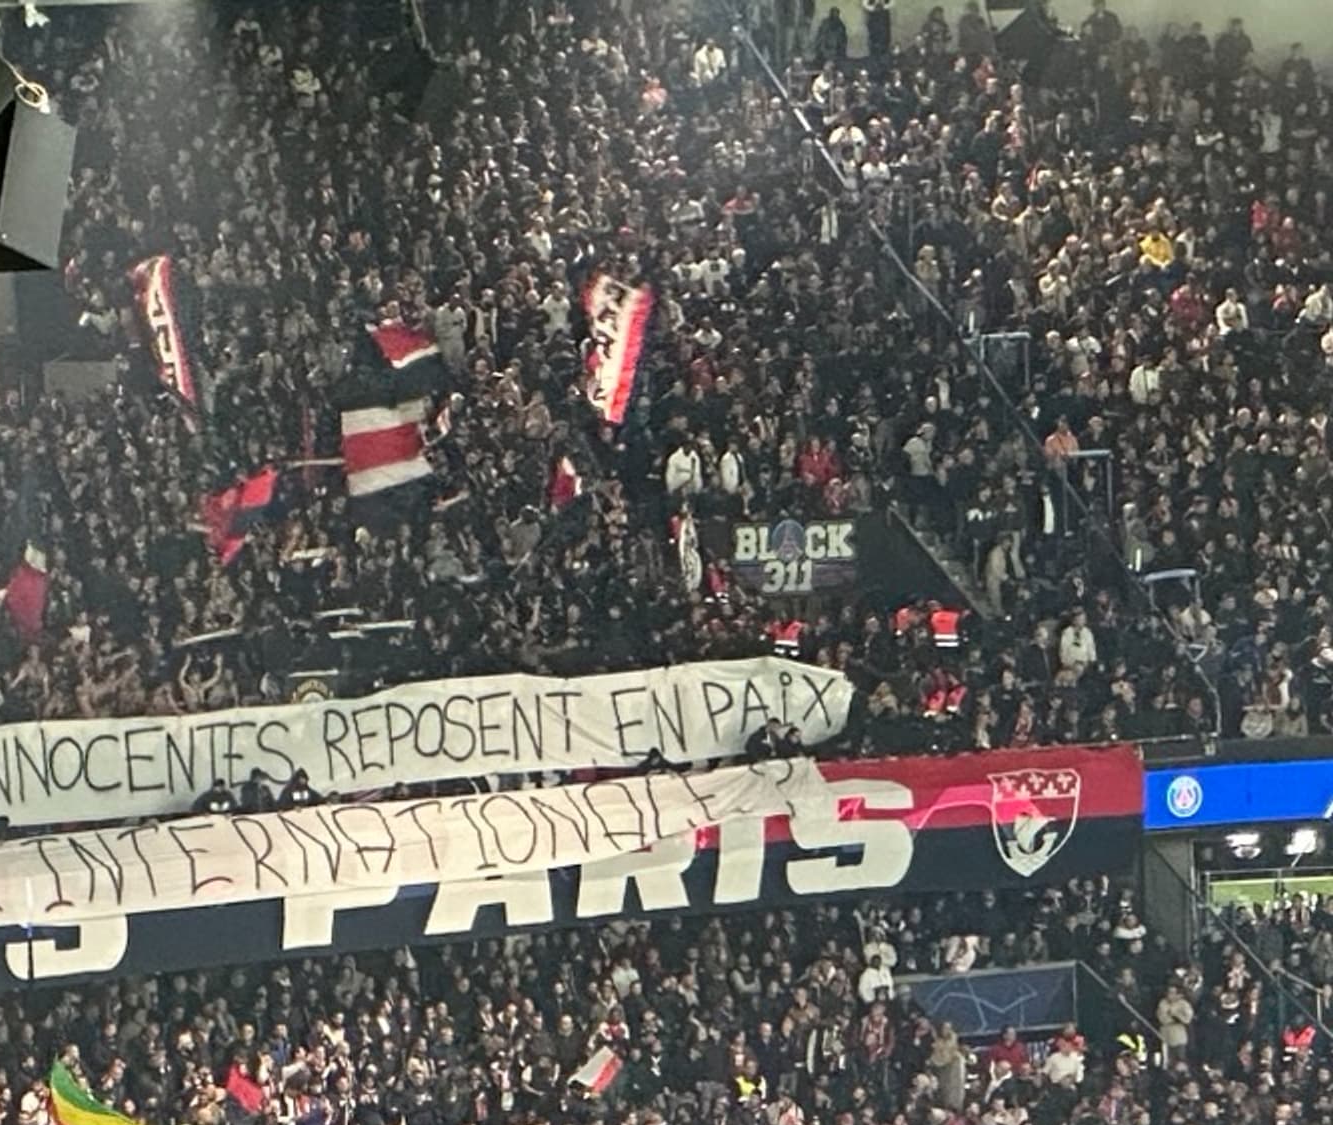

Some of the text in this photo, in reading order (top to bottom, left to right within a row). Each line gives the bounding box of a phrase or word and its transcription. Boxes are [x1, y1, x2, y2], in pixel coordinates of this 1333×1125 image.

[761, 559, 813, 593] 311
[321, 690, 583, 781] REPOSENT
[610, 684, 688, 756] EN
